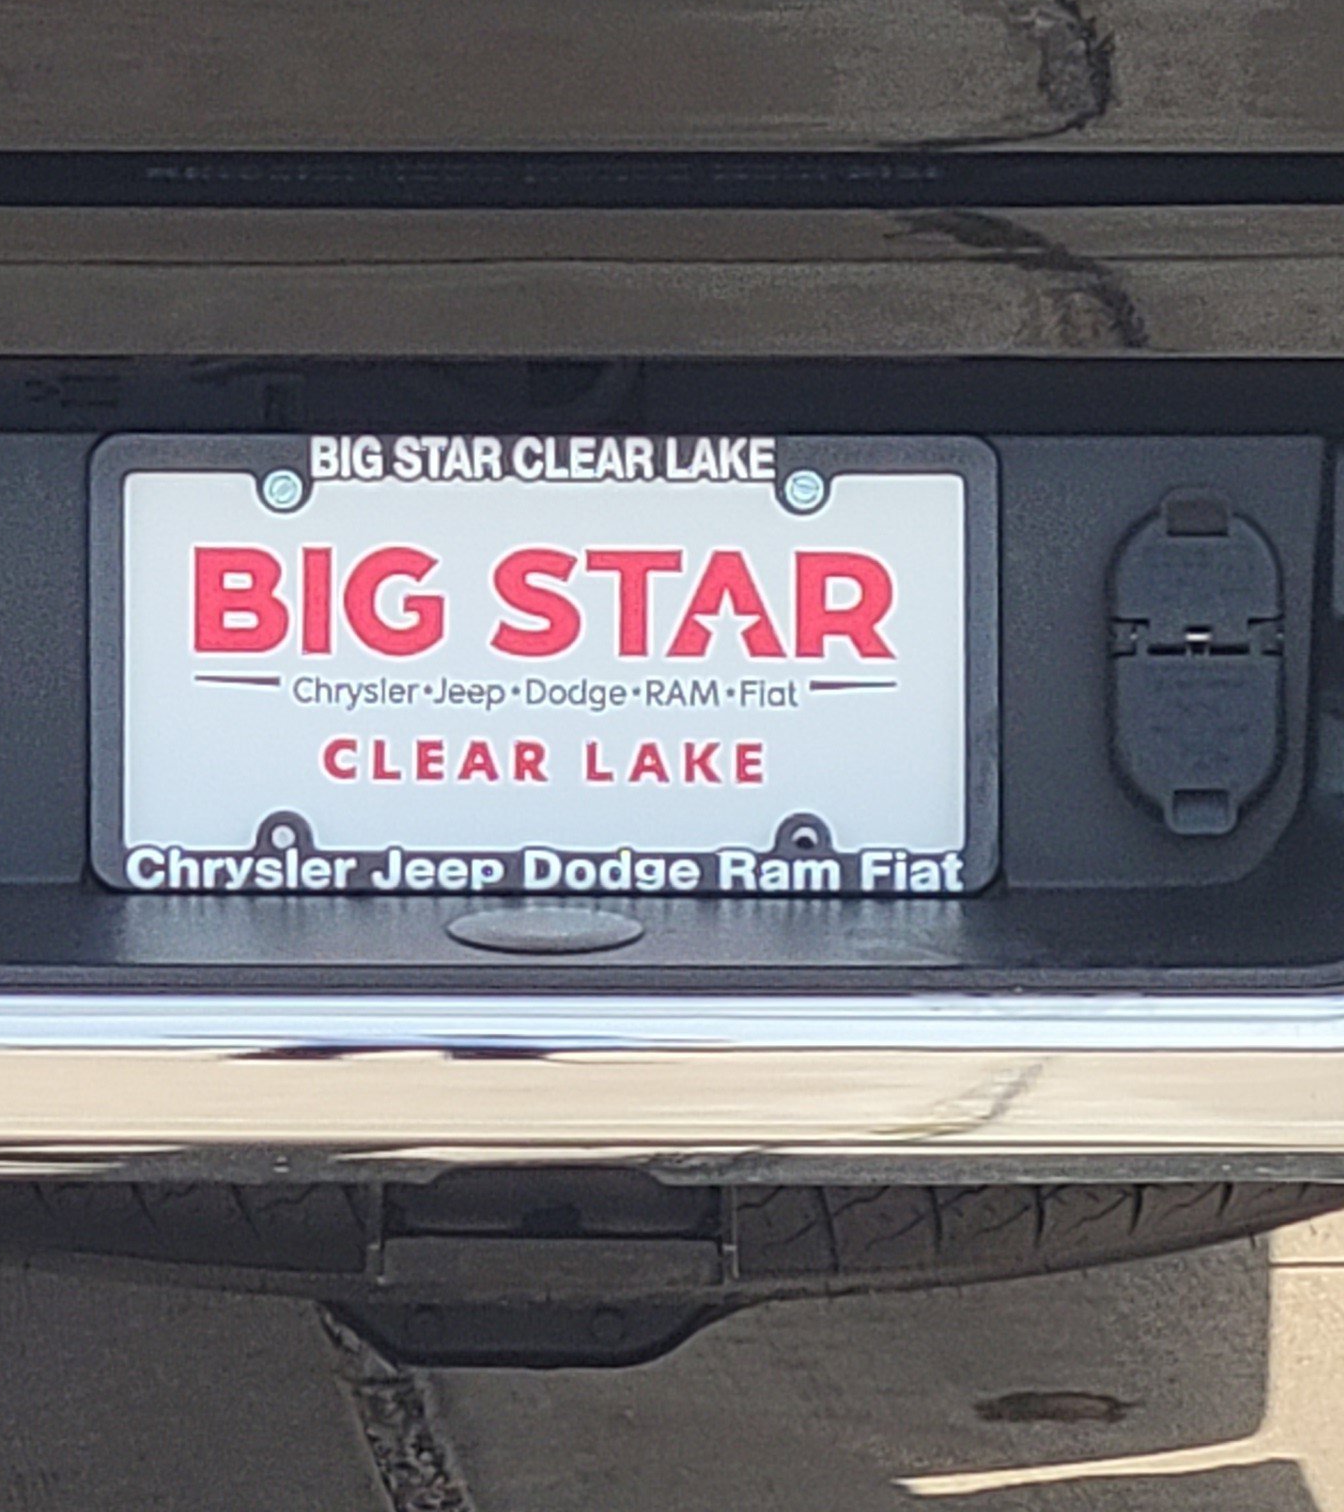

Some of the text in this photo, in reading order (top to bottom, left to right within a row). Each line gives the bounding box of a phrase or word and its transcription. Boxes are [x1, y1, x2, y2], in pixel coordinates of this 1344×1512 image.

[310, 436, 775, 481] BIG STAR CLEAR LAKE
[194, 546, 896, 660] BIG STAR
[322, 738, 764, 784] CLEAR LAKE
[125, 848, 963, 893] Chrysler Jeep Dodge Ram Fiat
